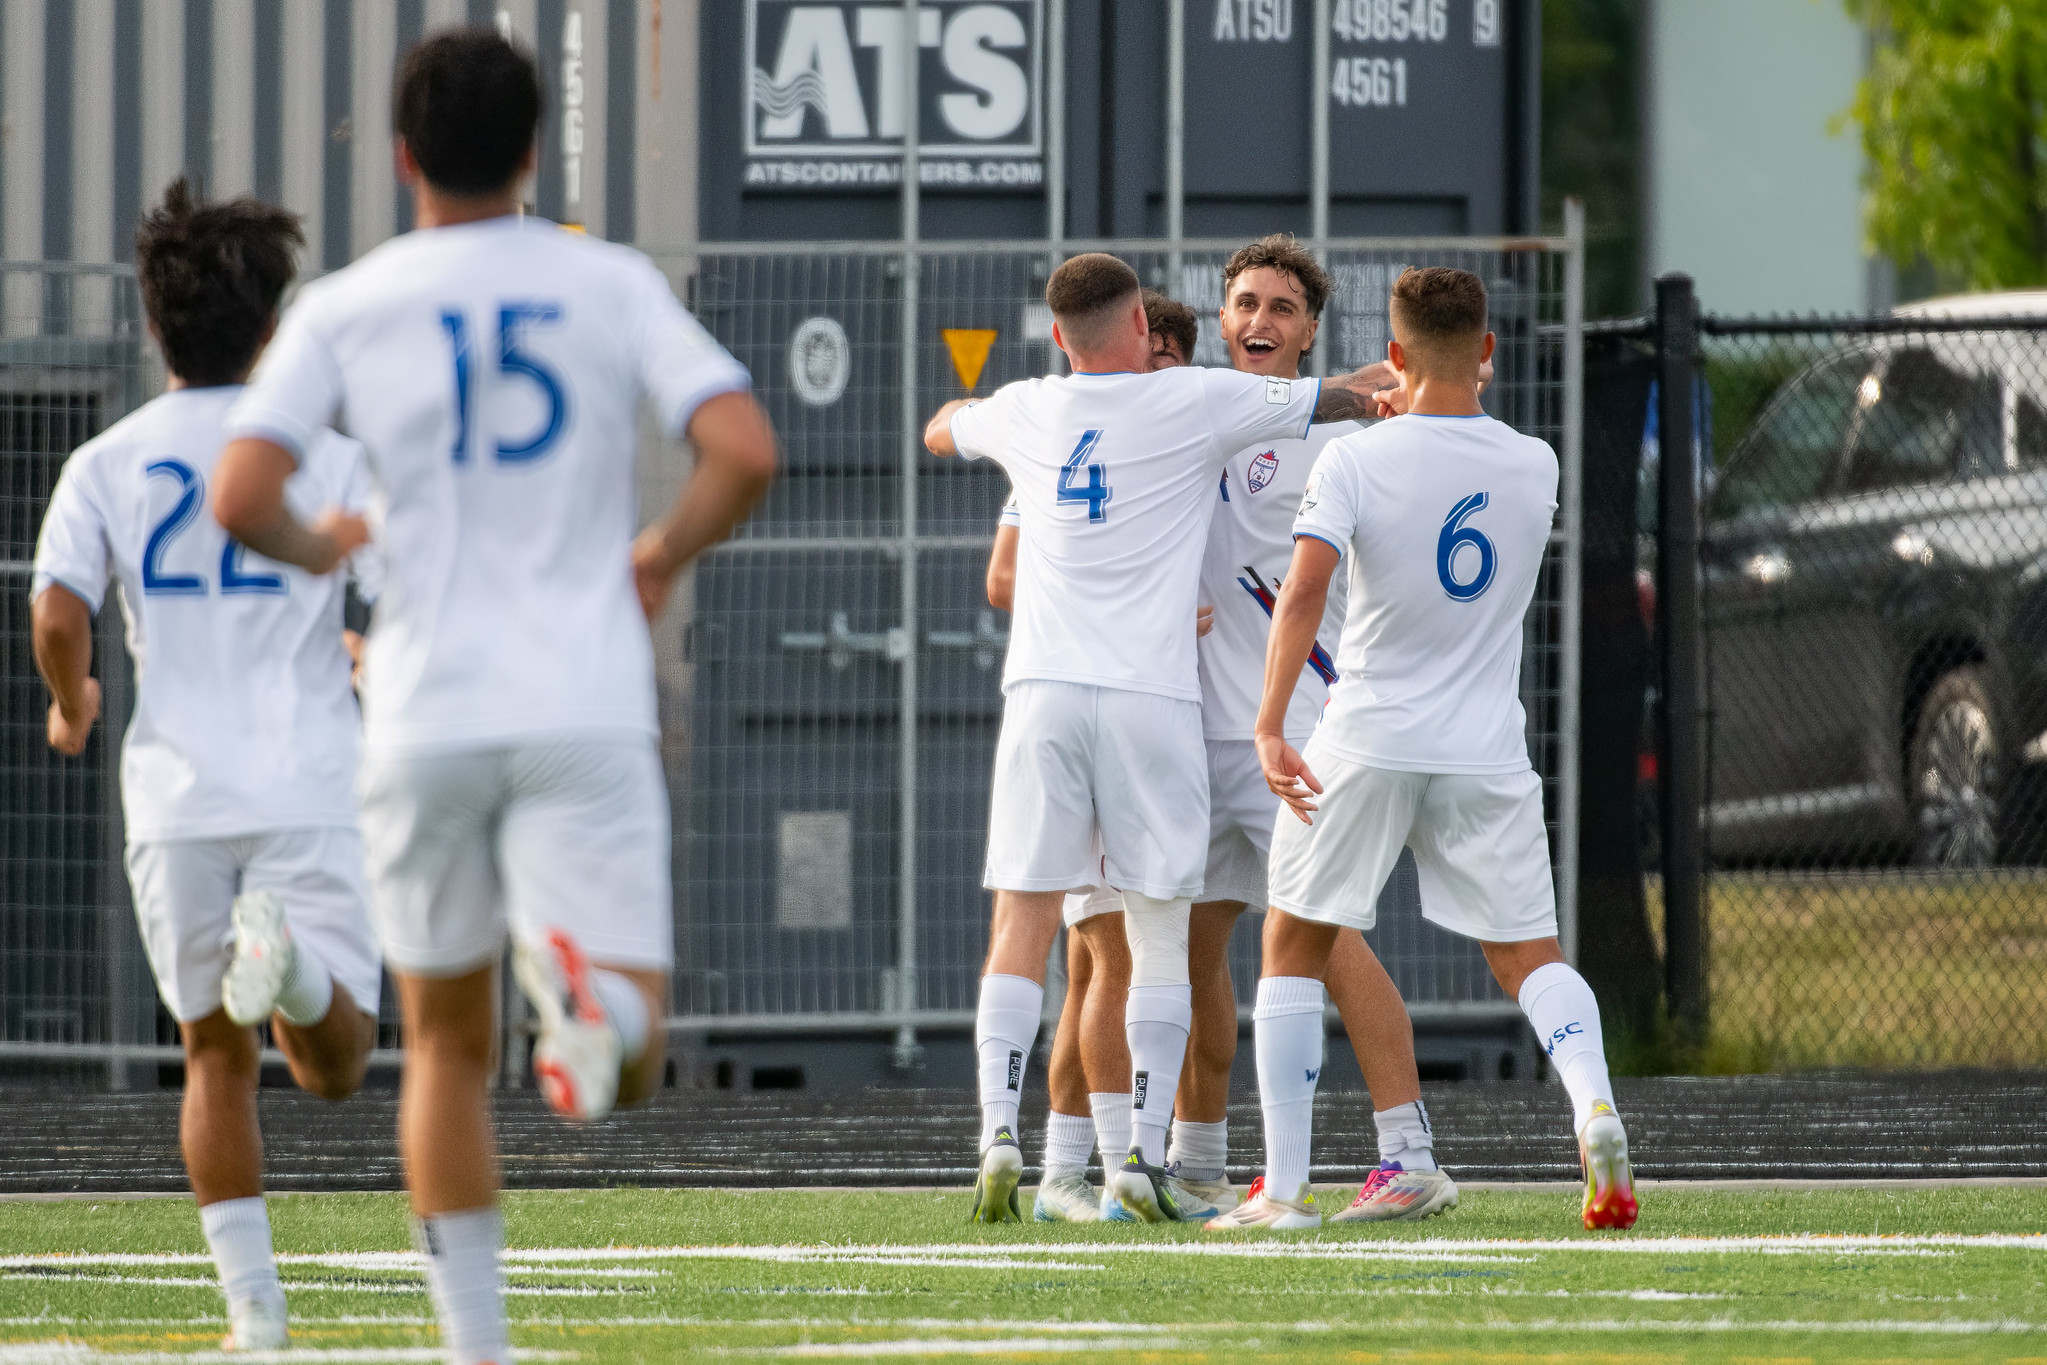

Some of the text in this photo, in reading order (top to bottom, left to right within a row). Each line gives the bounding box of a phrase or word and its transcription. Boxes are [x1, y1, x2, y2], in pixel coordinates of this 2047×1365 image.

[1214, 0, 1496, 41] ATSU 498546 9
[761, 5, 1028, 139] ATS
[746, 162, 1042, 184] ATSCONTAIERS.COM
[440, 300, 572, 464] 15
[1056, 429, 1114, 525] 4
[1437, 491, 1498, 603] 6
[1546, 1021, 1584, 1056] WSC
[1008, 1056, 1021, 1085] PURE
[1134, 1077, 1146, 1105] PURE
